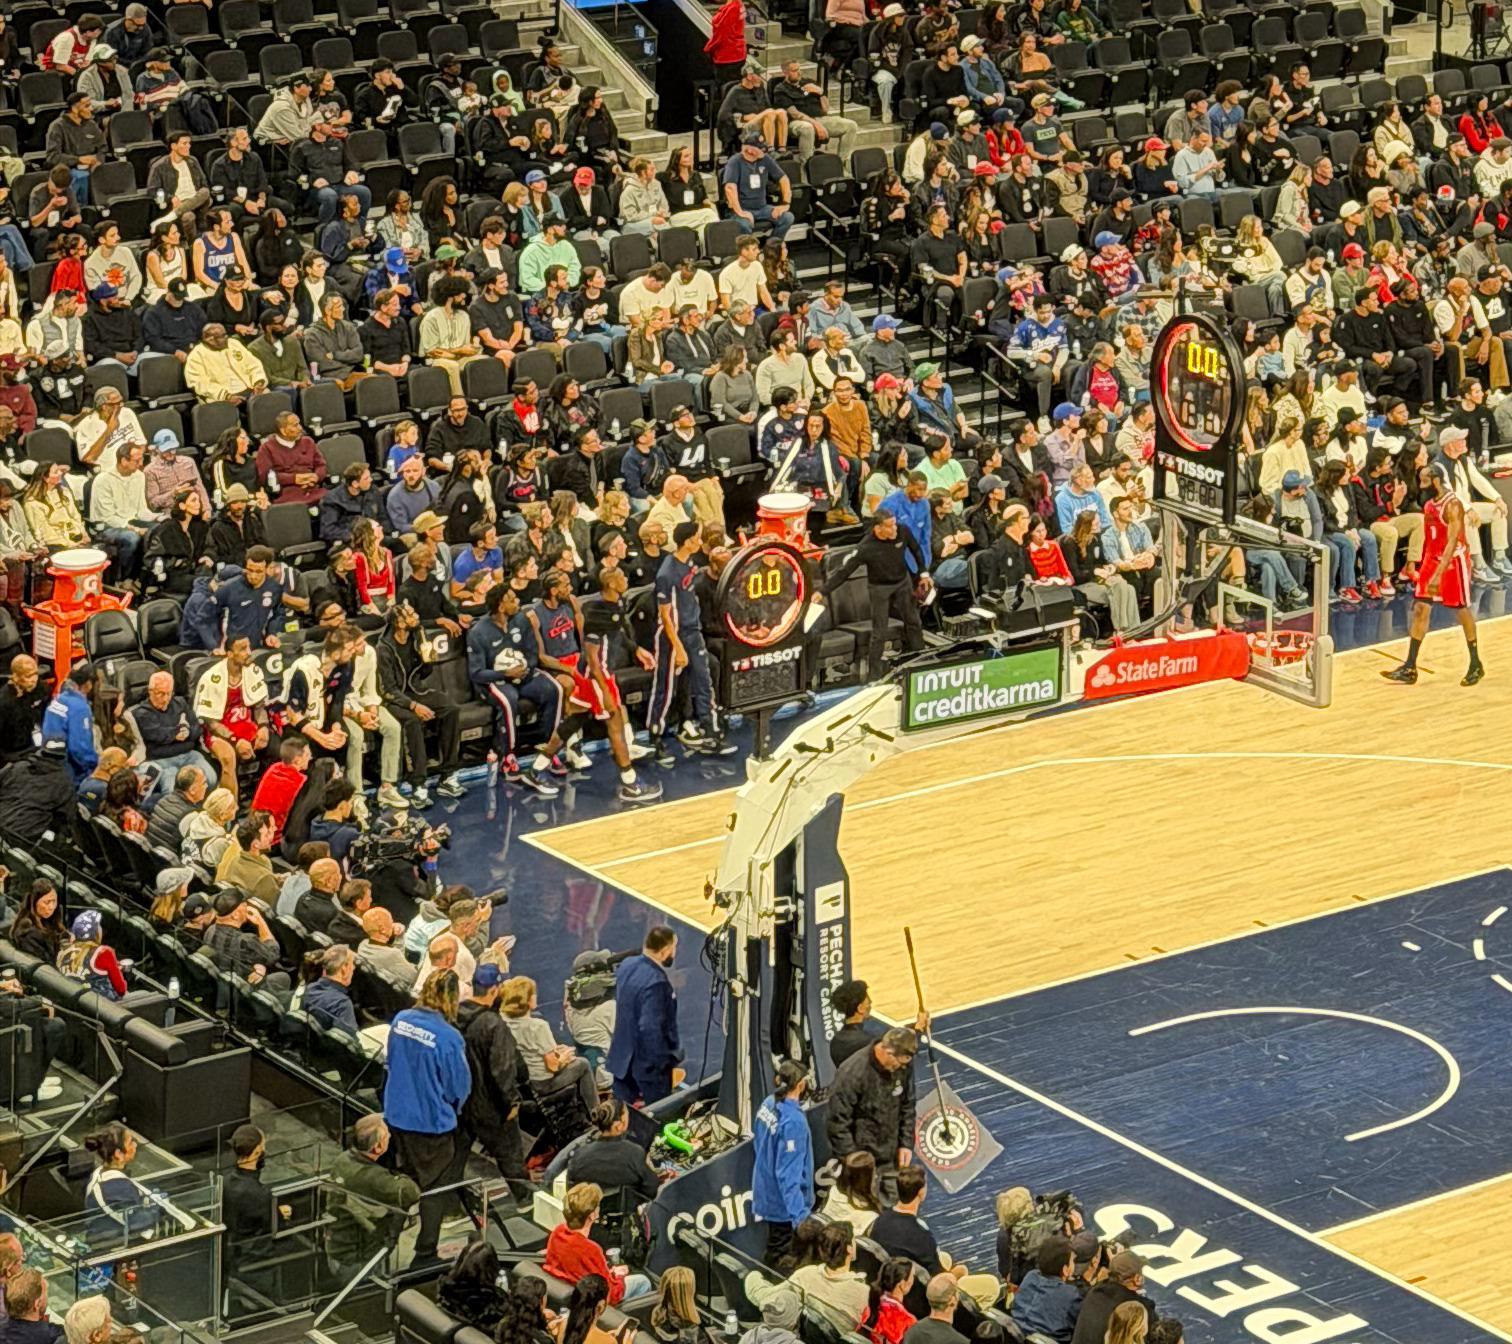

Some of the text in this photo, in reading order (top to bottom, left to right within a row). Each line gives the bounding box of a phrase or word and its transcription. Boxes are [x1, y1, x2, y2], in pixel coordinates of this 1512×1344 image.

[1188, 342, 1218, 379] 0.0
[1176, 457, 1224, 486] TISSOT
[748, 570, 781, 599] 0.0
[751, 646, 802, 668] TISSOT
[914, 680, 1053, 722] creditkarma
[819, 928, 834, 1041] RESORT CASINO
